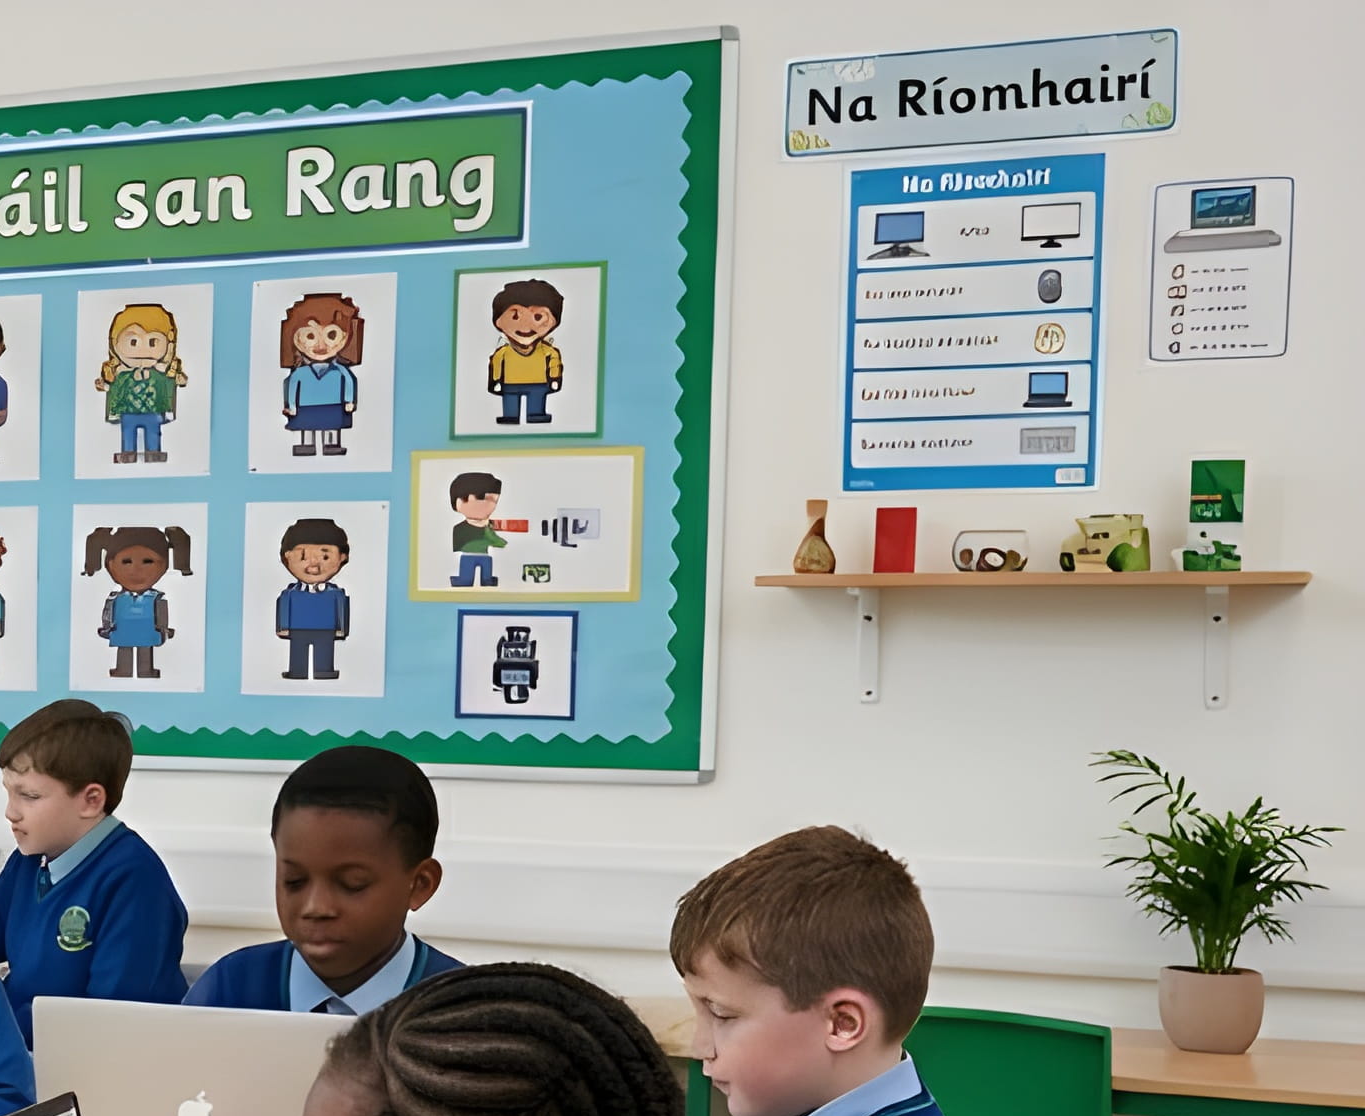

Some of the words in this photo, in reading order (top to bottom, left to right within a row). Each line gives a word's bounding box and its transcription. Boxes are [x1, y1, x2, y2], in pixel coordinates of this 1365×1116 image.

[807, 87, 877, 126] Na
[897, 58, 1158, 118] Ríomhairí
[113, 174, 253, 230] san
[284, 146, 496, 234] Rang
